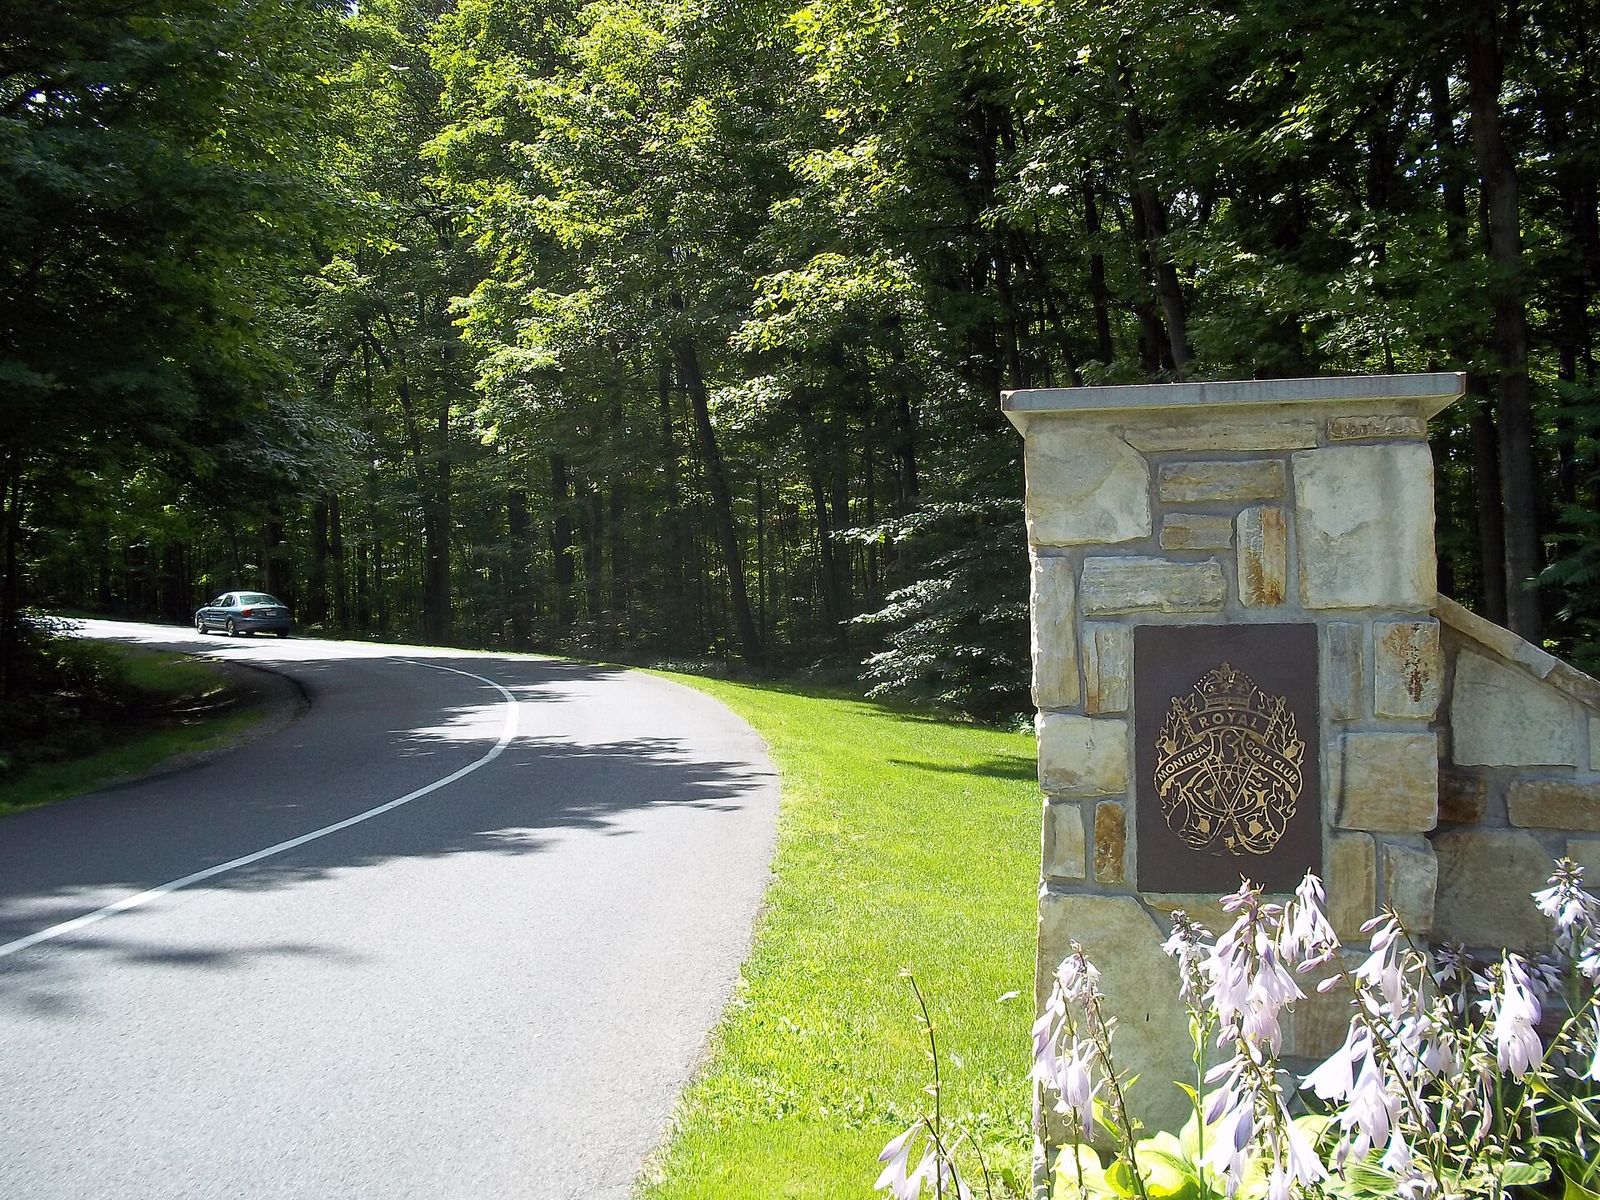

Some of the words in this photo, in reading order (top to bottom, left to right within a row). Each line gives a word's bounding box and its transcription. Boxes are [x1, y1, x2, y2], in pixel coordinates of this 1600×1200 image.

[1198, 712, 1258, 729] ROYAL
[1158, 743, 1211, 782] MONTREAL
[1246, 741, 1272, 763] GOLF
[1272, 759, 1299, 784] CLUB
